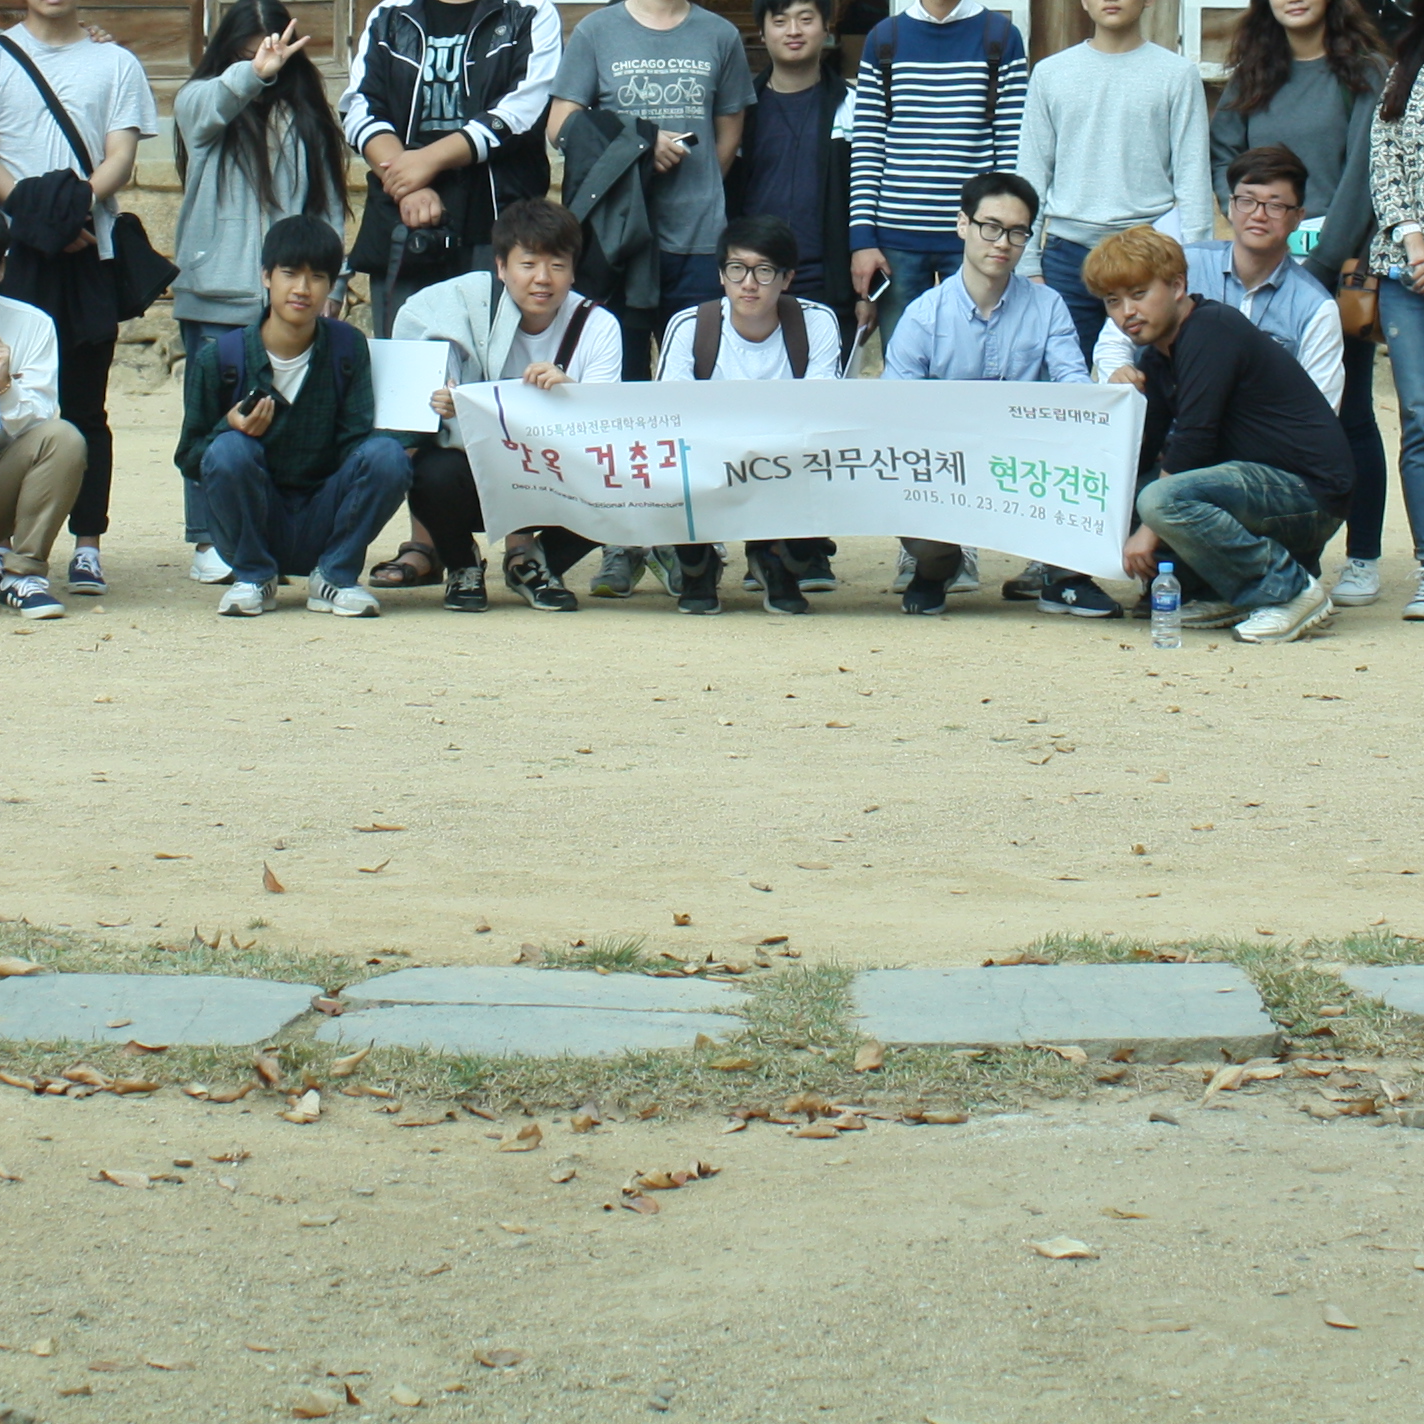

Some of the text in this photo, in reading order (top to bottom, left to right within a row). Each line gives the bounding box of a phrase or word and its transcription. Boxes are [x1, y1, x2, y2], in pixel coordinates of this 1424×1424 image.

[611, 58, 712, 72] CHICAGO CYCLES
[526, 414, 682, 437] 2015특성화전문대학육성사업
[1008, 405, 1111, 426] 전남도립대학교
[501, 438, 691, 489] 한옥 건축과
[723, 446, 1109, 513] NCS 직무산업체 현장견학
[549, 487, 578, 502] Korean
[628, 501, 684, 509] Architecture
[1029, 505, 1046, 520] 28
[1053, 510, 1105, 536] 송도건설
